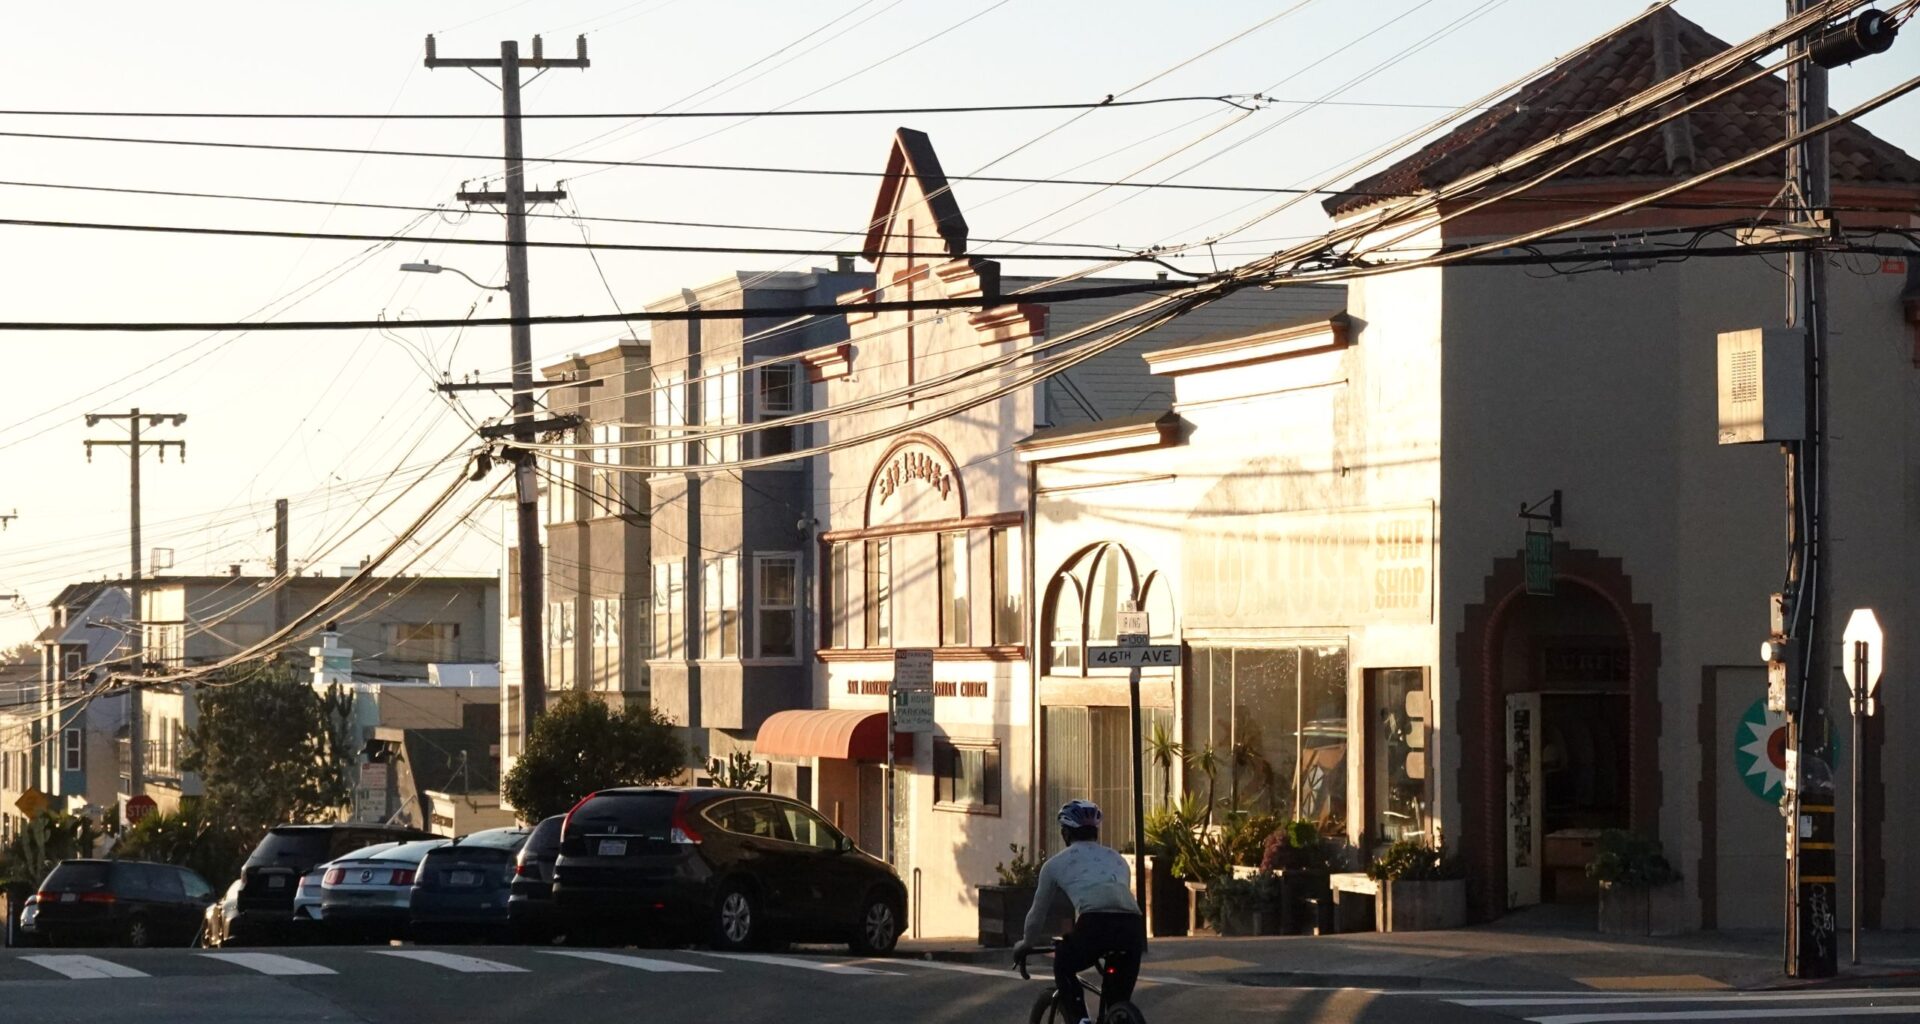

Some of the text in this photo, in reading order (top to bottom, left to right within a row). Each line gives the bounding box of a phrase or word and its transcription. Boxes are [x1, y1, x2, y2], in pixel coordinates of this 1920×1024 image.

[1375, 519, 1425, 561] SURF
[1374, 566, 1425, 609] SHOP
[1096, 649, 1172, 664] 46TH AVE
[960, 681, 988, 698] CHURCH
[897, 708, 933, 717] PARKING
[128, 804, 156, 818] STOP
